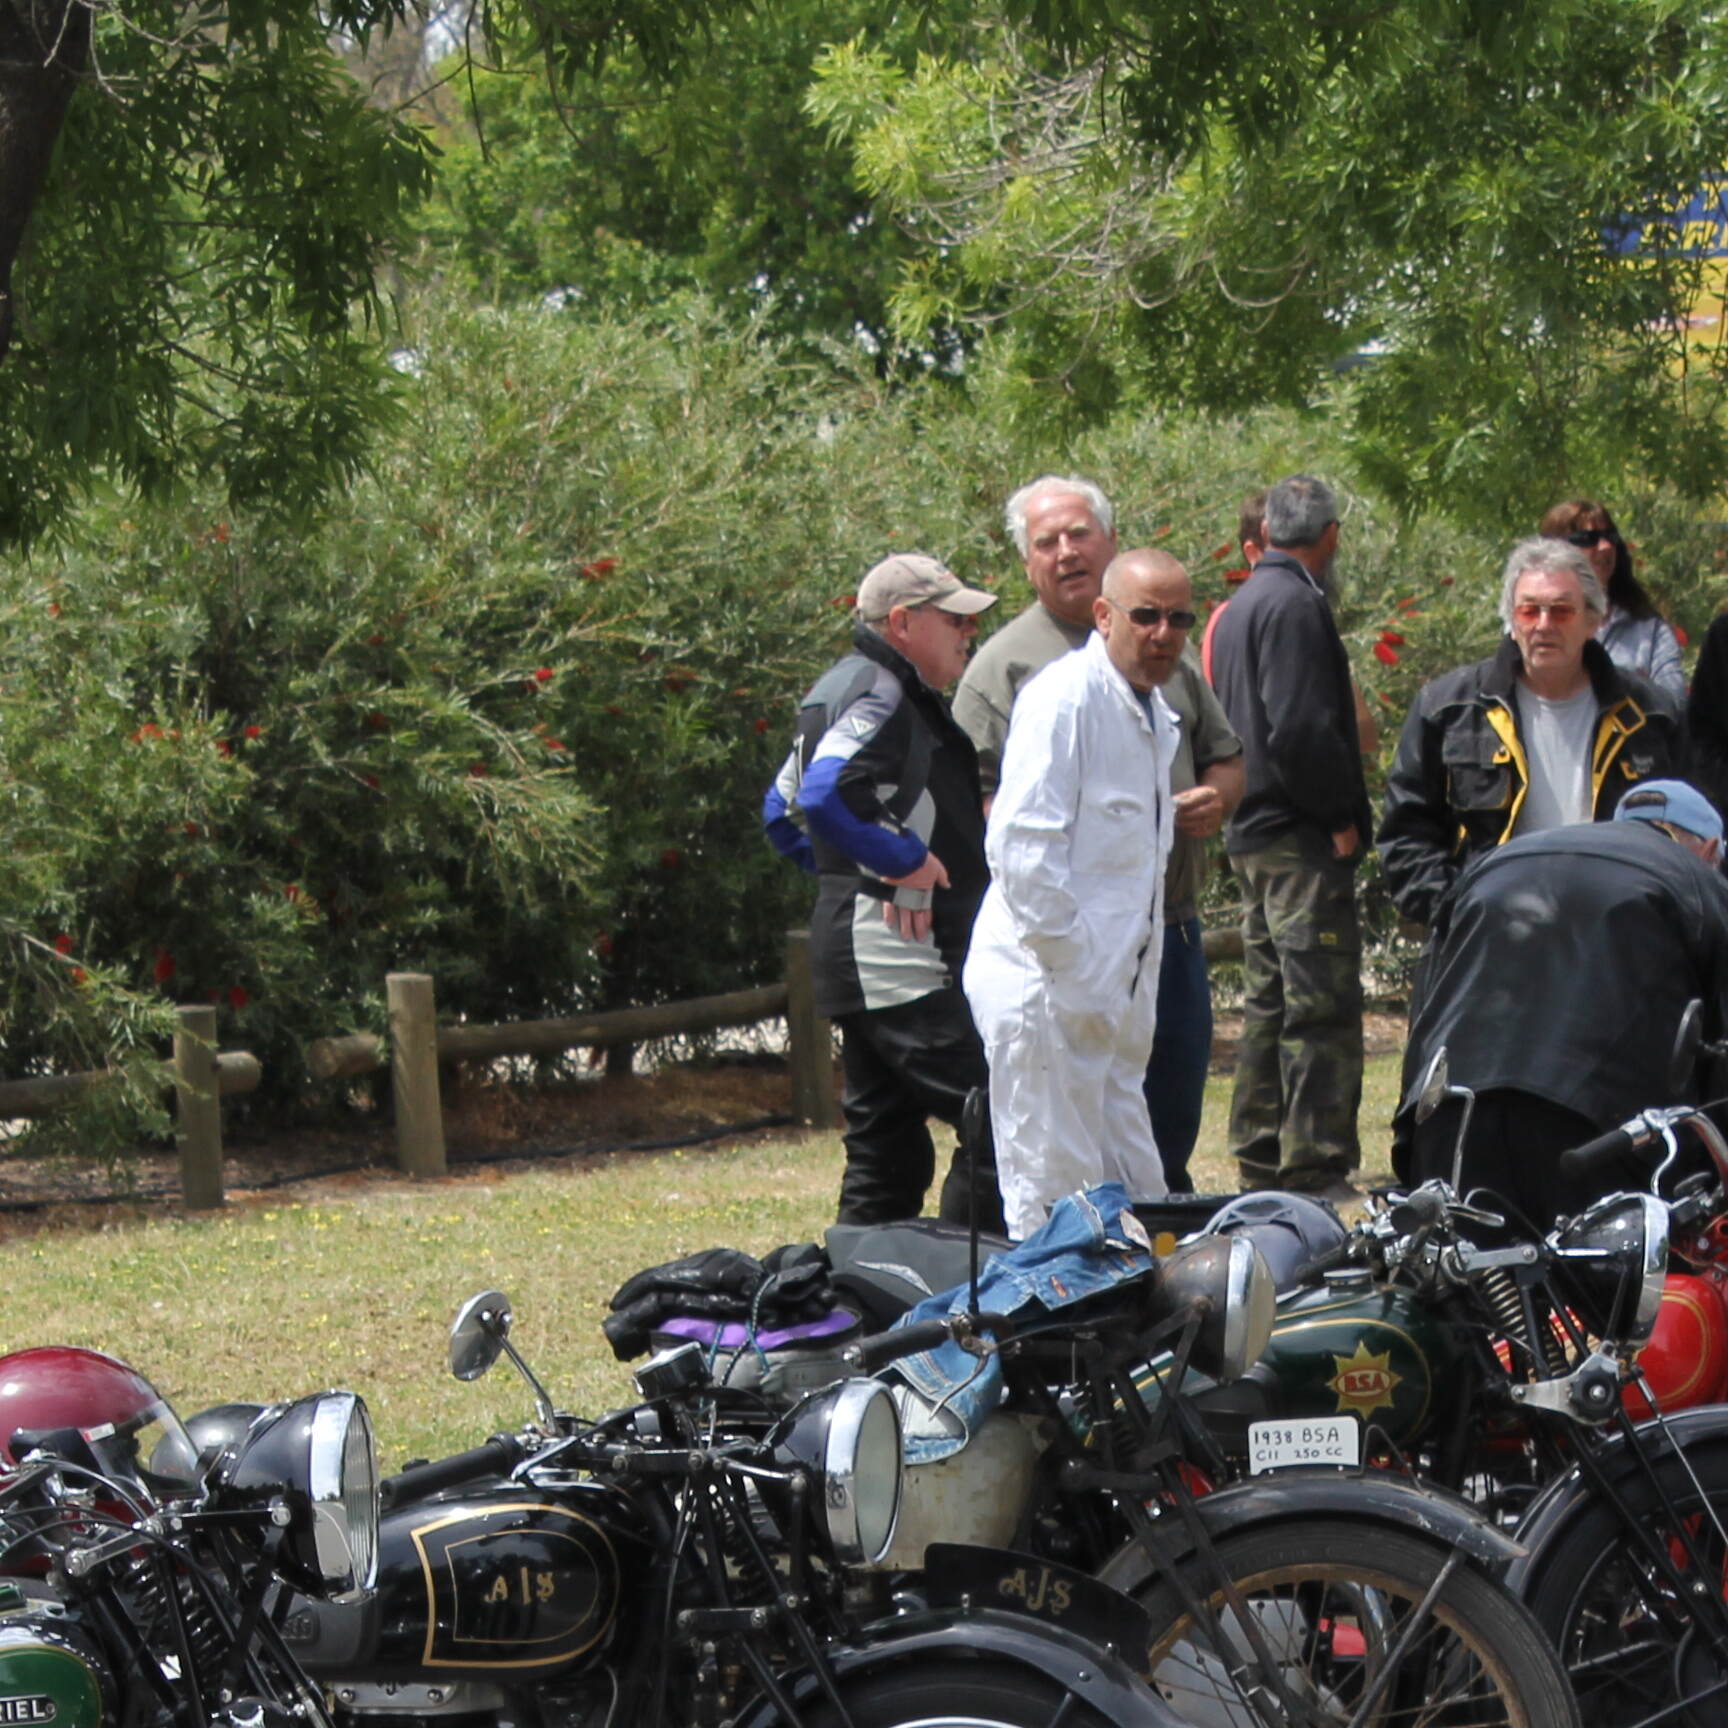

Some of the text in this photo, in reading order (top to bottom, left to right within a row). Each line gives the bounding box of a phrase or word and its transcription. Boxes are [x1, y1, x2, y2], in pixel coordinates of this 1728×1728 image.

[1344, 1373, 1385, 1393] BSA
[1254, 1427, 1340, 1446] 1938 BSA
[1294, 1448, 1320, 1459] 250
